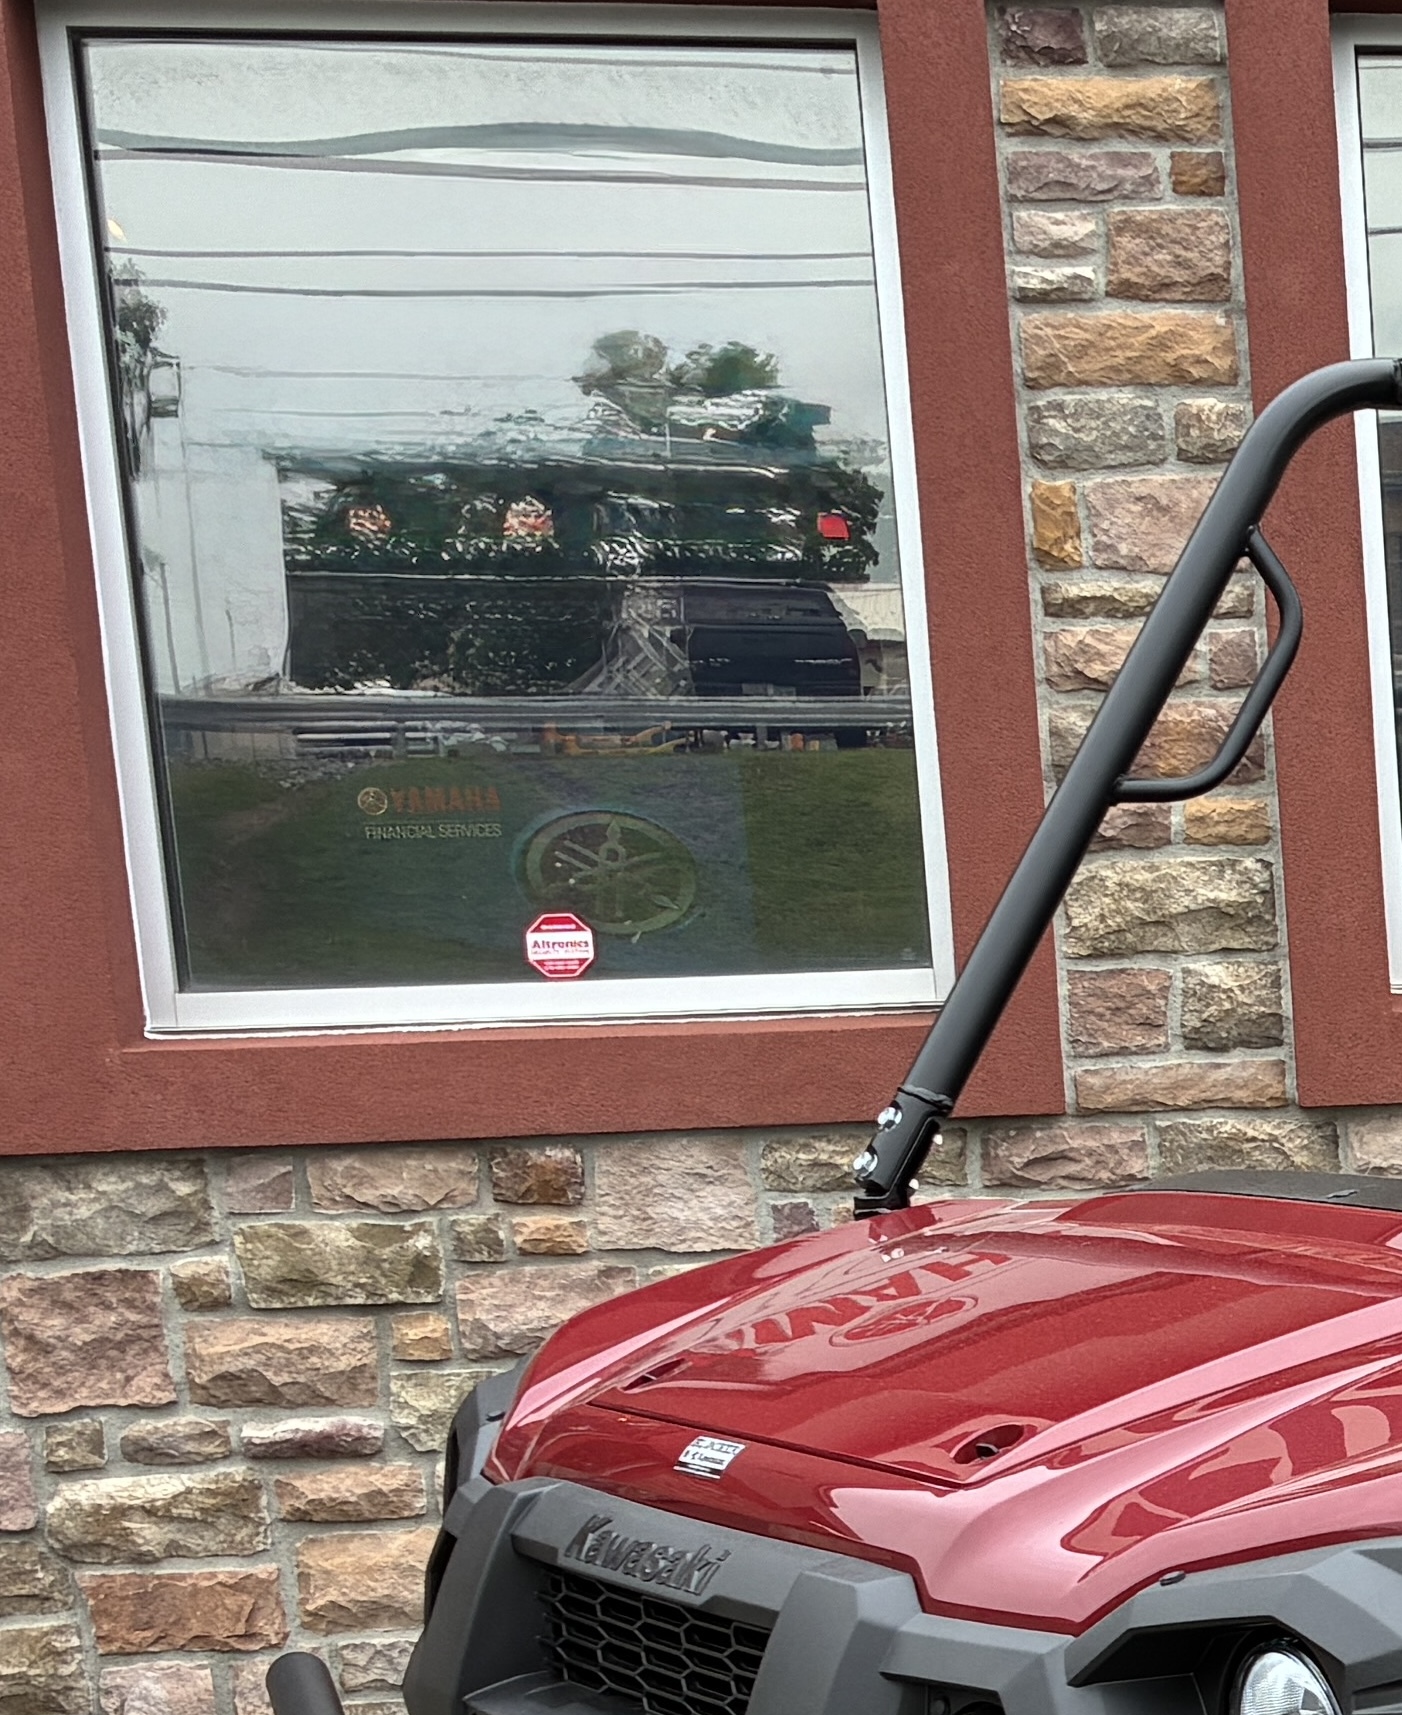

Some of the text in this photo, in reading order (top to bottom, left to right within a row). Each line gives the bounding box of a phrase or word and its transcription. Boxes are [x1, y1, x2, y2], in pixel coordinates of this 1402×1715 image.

[391, 785, 501, 815] YAMAHA
[364, 822, 503, 840] FINANCIAL SERVICES
[531, 939, 590, 950] Altronics
[564, 1513, 733, 1596] Kawasaki
